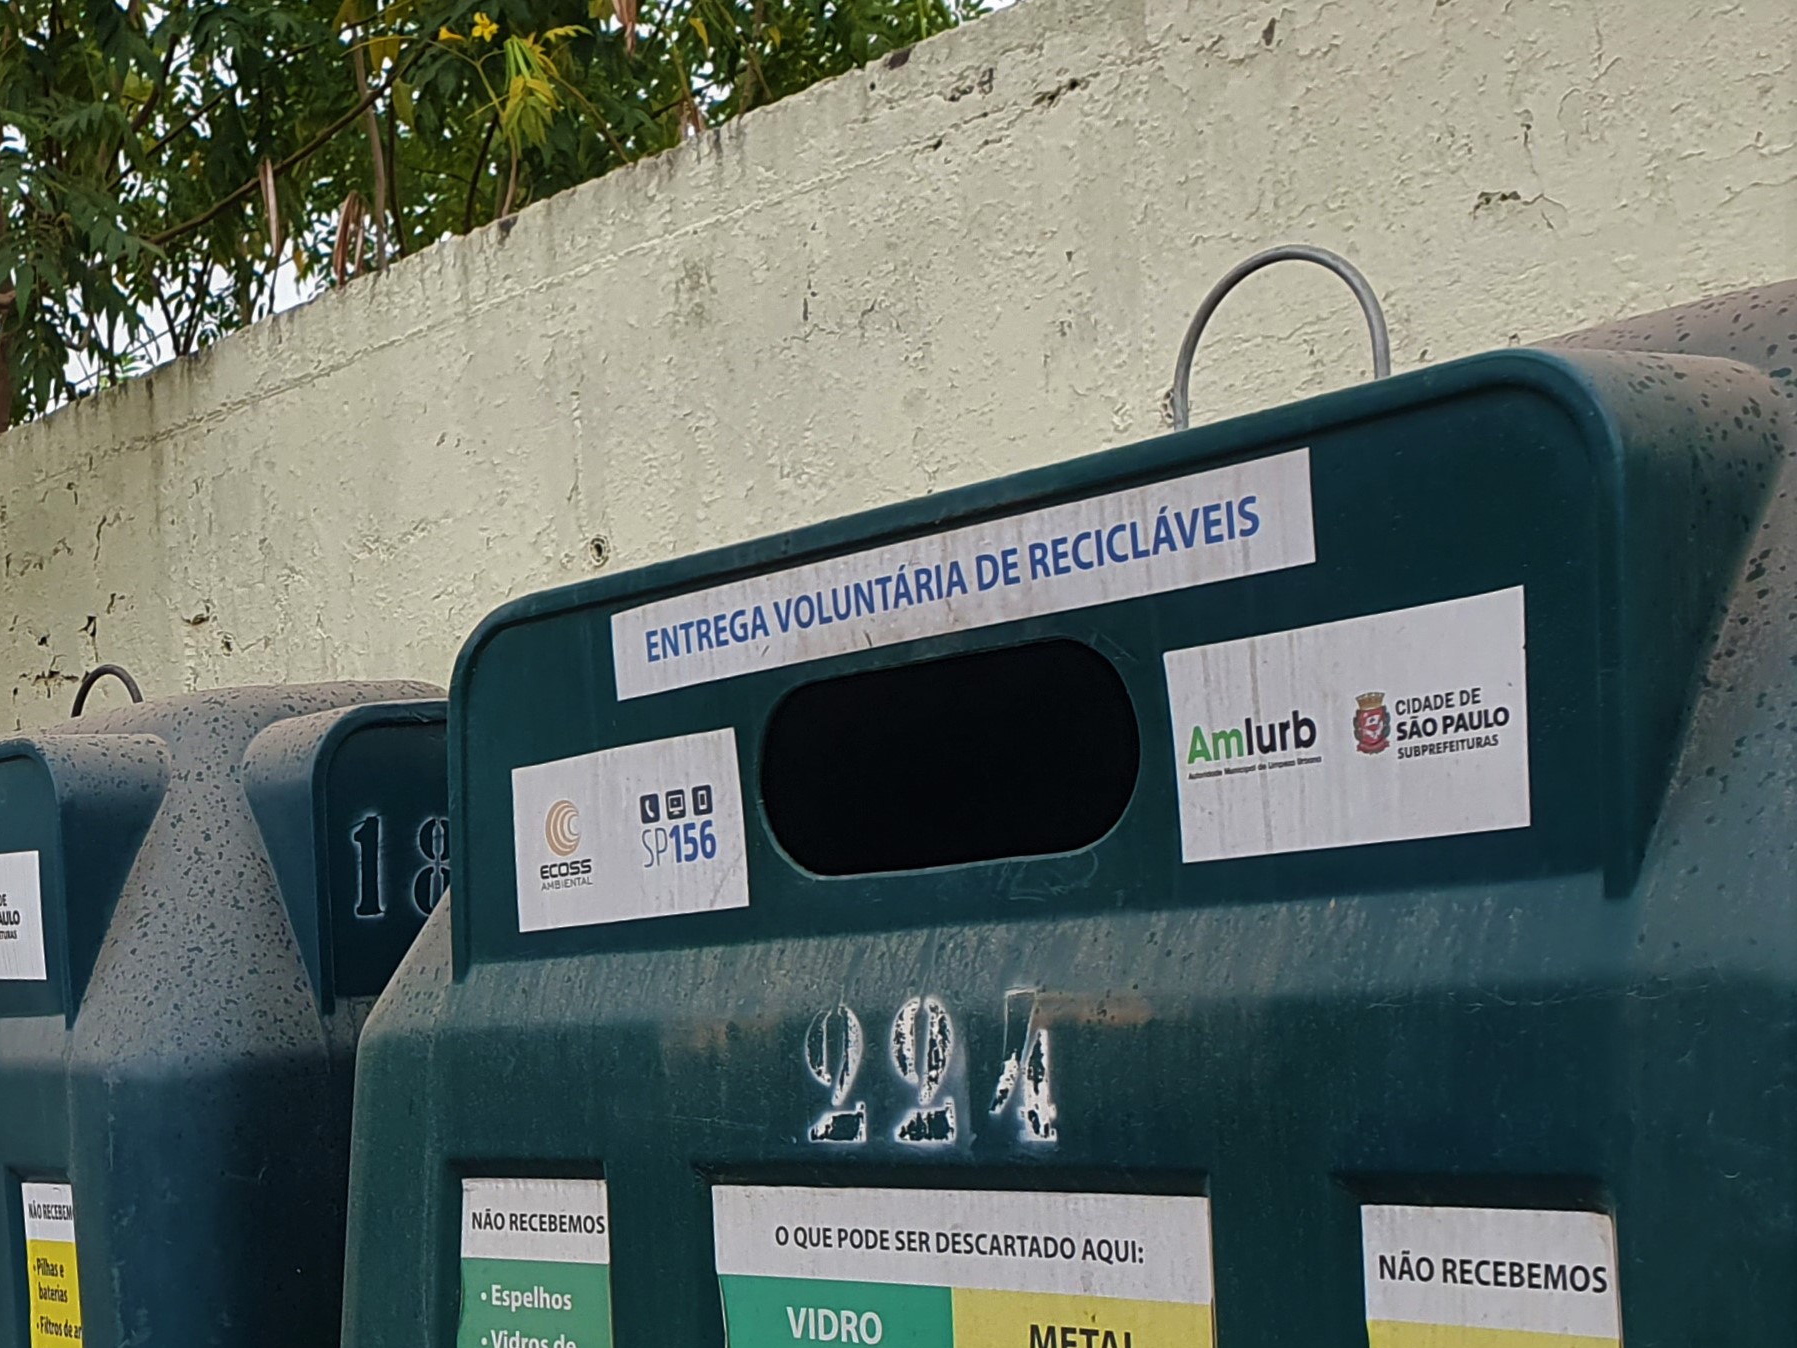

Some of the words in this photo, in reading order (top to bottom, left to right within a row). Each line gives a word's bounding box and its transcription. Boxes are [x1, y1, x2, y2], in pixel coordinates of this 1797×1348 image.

[645, 605, 770, 664] ENTREGA
[775, 562, 968, 635] VOLUNTÁRIA
[976, 548, 1020, 592] DE
[1028, 495, 1260, 580] RECICLÁVEIS
[1395, 692, 1453, 716] CIDADE
[1459, 688, 1482, 707] DE
[1187, 710, 1317, 764] Amlurb
[1396, 714, 1437, 741] SÃO
[1442, 706, 1510, 735] PAULO
[1397, 734, 1499, 760] SUBPREFEITURAS
[641, 819, 717, 868] SP156
[539, 858, 592, 879] ECOSS
[540, 878, 593, 892] AMBIENTAL
[471, 1208, 505, 1231] NÃO
[509, 1212, 605, 1234] RECEBEMOS
[775, 1226, 789, 1247] O
[794, 1227, 833, 1251] QUE
[837, 1228, 891, 1252] PODE
[895, 1230, 931, 1253] SER
[935, 1231, 1076, 1261] DESCARTADO
[1081, 1237, 1145, 1265] AQUI:
[1378, 1250, 1435, 1283] NÃO
[1442, 1257, 1608, 1294] RECEBEMOS
[491, 1284, 572, 1312] Espelhos
[786, 1306, 884, 1345] VIDRO
